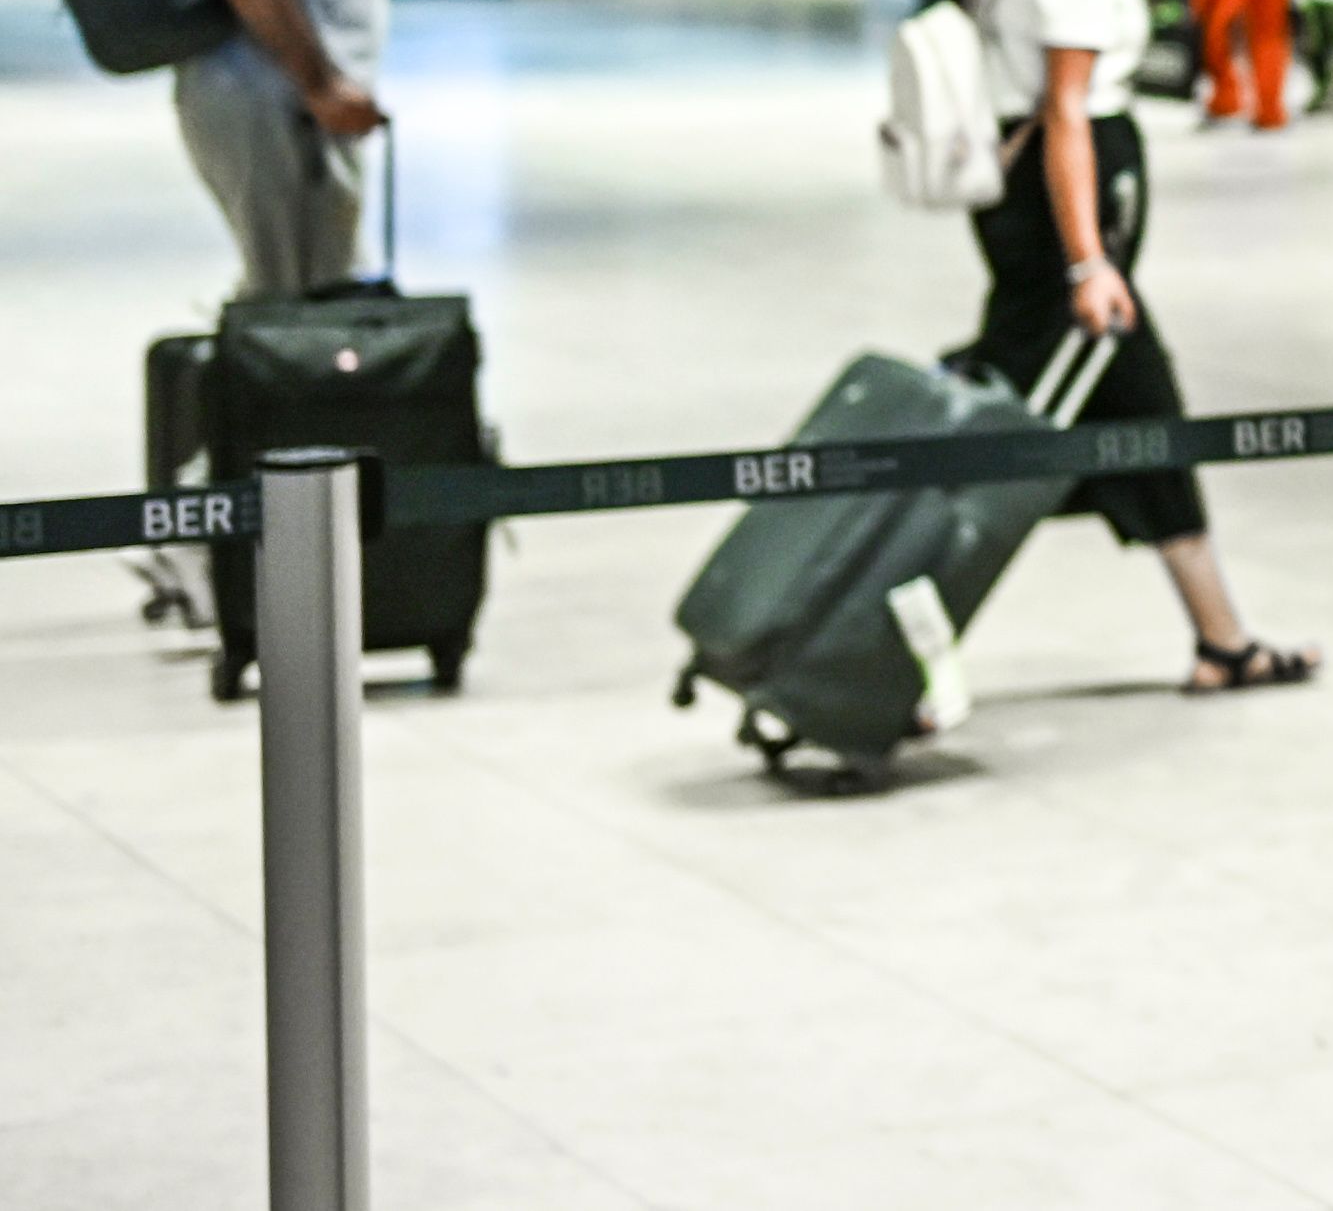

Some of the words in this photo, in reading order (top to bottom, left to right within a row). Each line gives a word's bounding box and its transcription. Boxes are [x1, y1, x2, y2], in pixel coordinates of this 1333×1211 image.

[1233, 421, 1305, 457] BER
[733, 451, 814, 495] BER
[142, 493, 234, 539] BER
